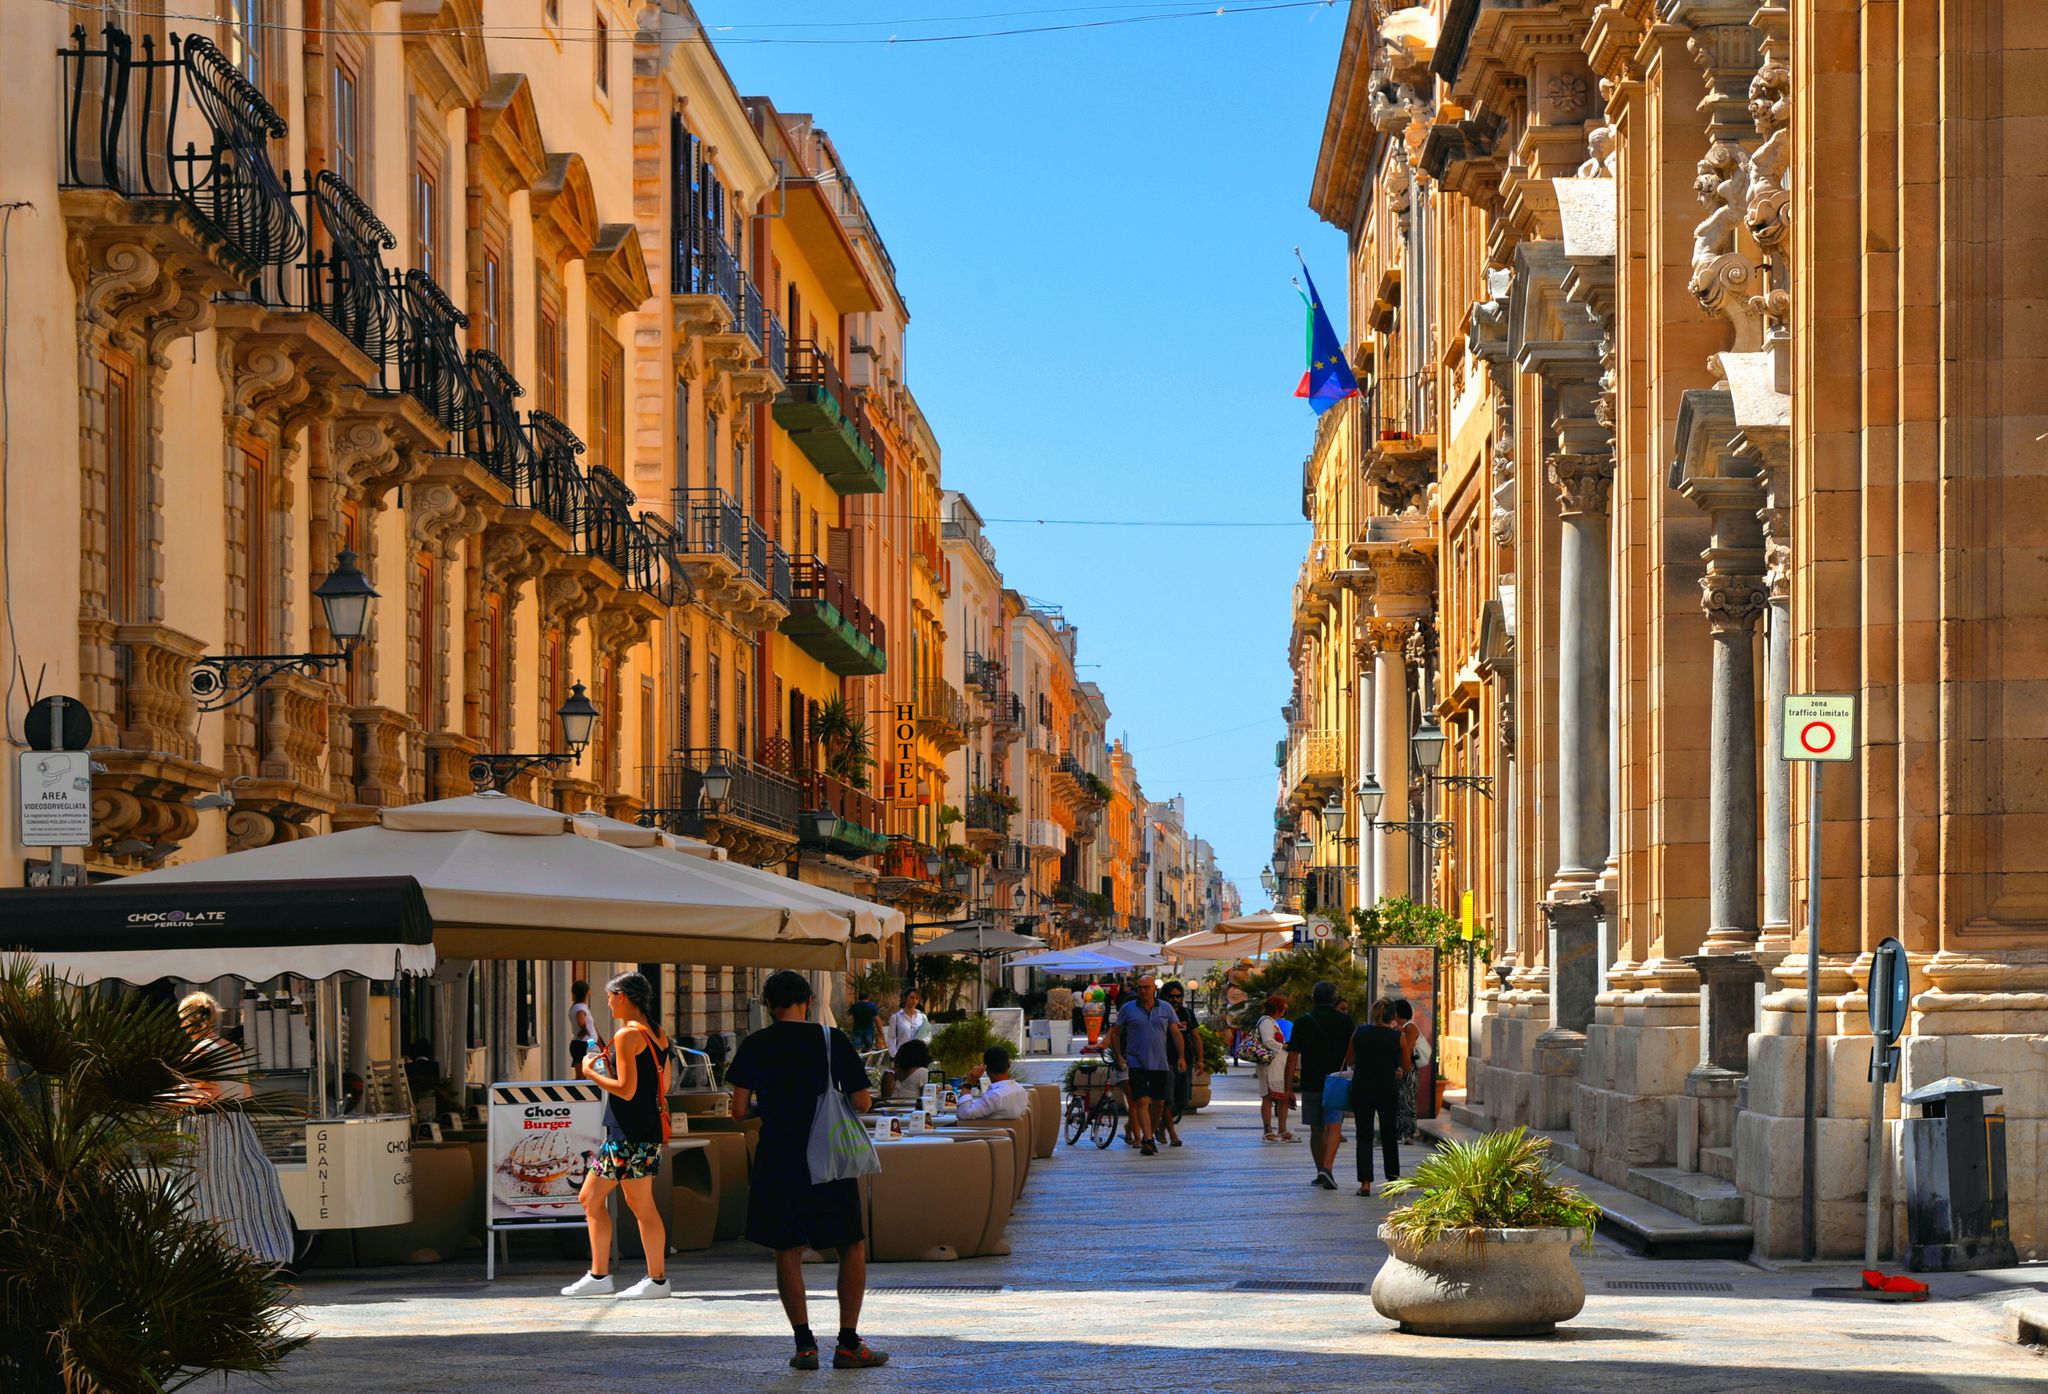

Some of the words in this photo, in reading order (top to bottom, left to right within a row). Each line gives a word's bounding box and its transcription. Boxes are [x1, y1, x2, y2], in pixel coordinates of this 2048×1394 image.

[1788, 709, 1817, 717] traffico
[1819, 709, 1850, 717] limitato
[896, 704, 915, 798] HOTEL
[41, 792, 68, 800] AREA
[524, 1106, 571, 1117] Choco
[523, 1119, 572, 1131] Burger
[317, 1129, 328, 1219] GRANITE
